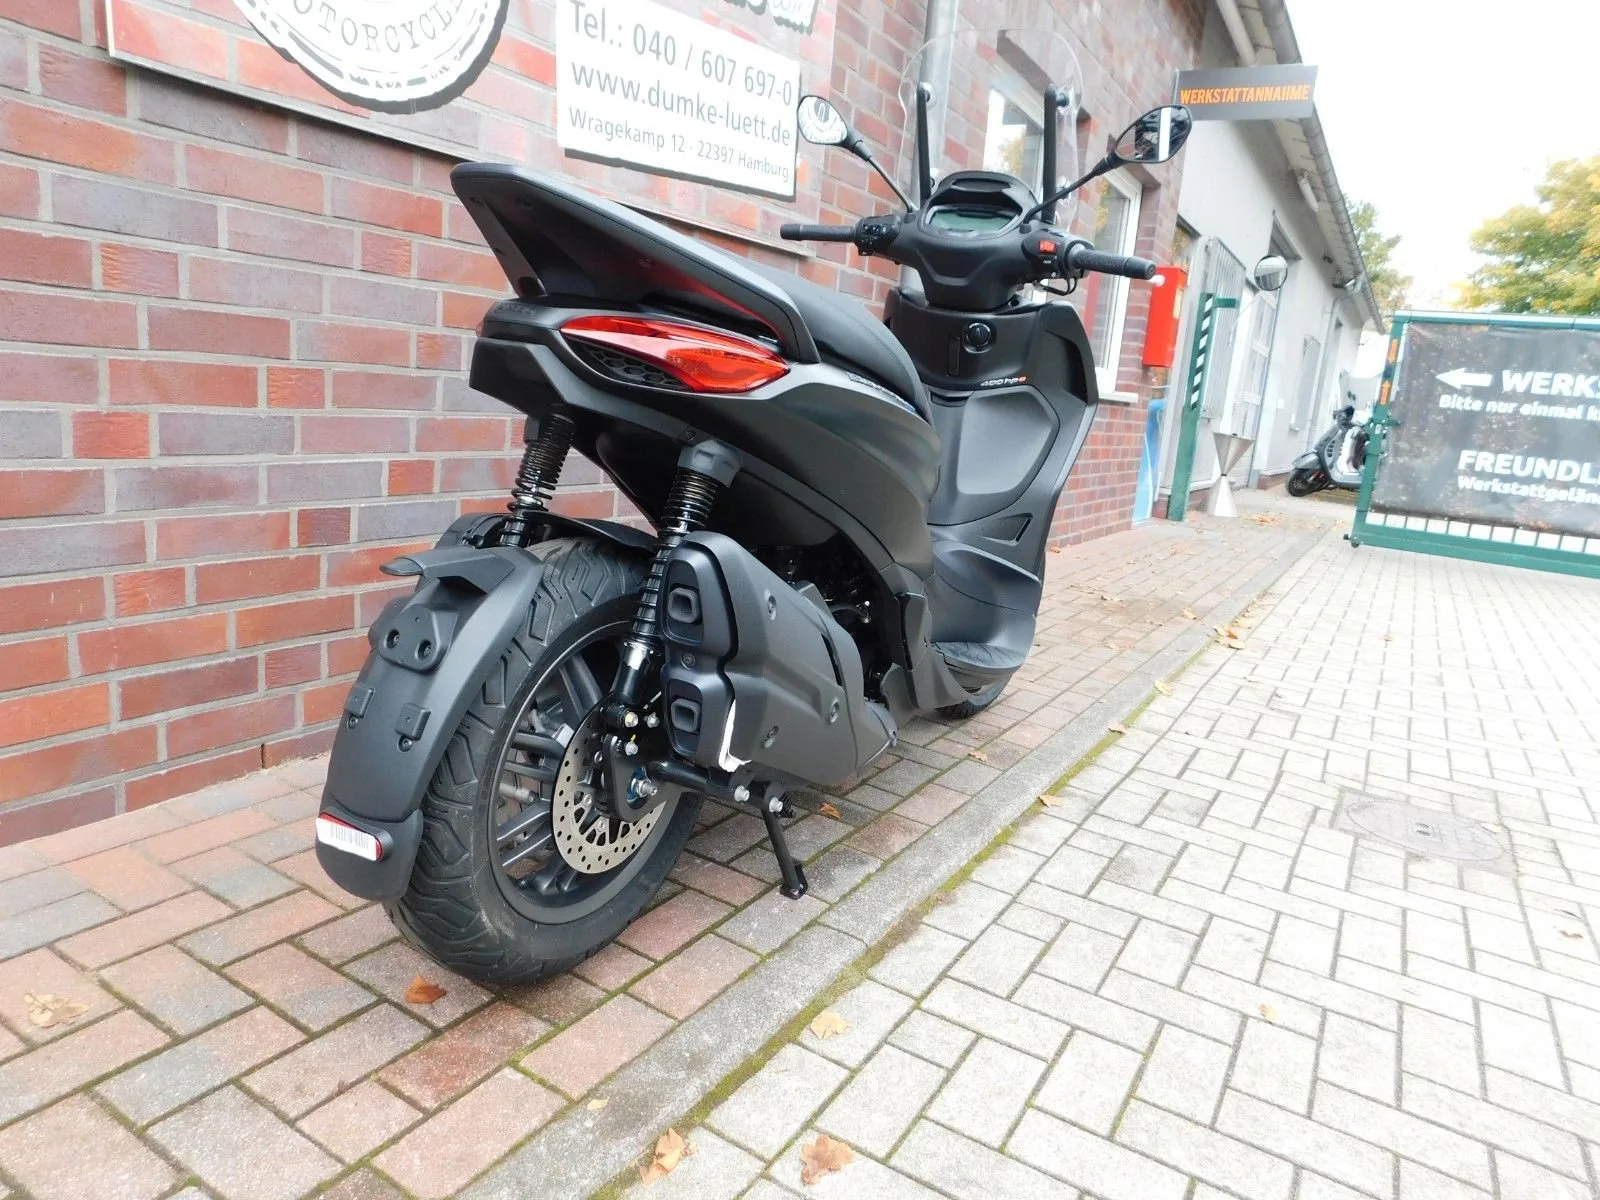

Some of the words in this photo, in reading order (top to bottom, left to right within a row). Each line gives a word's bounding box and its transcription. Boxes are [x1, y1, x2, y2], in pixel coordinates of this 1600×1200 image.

[570, 0, 623, 48] Tel.:
[633, 23, 676, 66] 040
[685, 43, 693, 71] /
[701, 49, 737, 85] 607
[744, 65, 792, 106] 697-0
[571, 61, 790, 146] www.dumke-luett.de
[1180, 85, 1310, 104] WERKSTATTANNAHME
[569, 106, 665, 149] Wragekamp
[671, 133, 685, 152] 12
[697, 140, 734, 165] 22397
[738, 155, 789, 183] Hamburg
[1502, 369, 1600, 399] WERK
[1439, 394, 1483, 411] Bitte
[1486, 400, 1519, 414] nur
[1520, 401, 1585, 419] einmal
[1458, 450, 1600, 484] FREUNDL
[1457, 475, 1600, 504] Werkstattgelän
